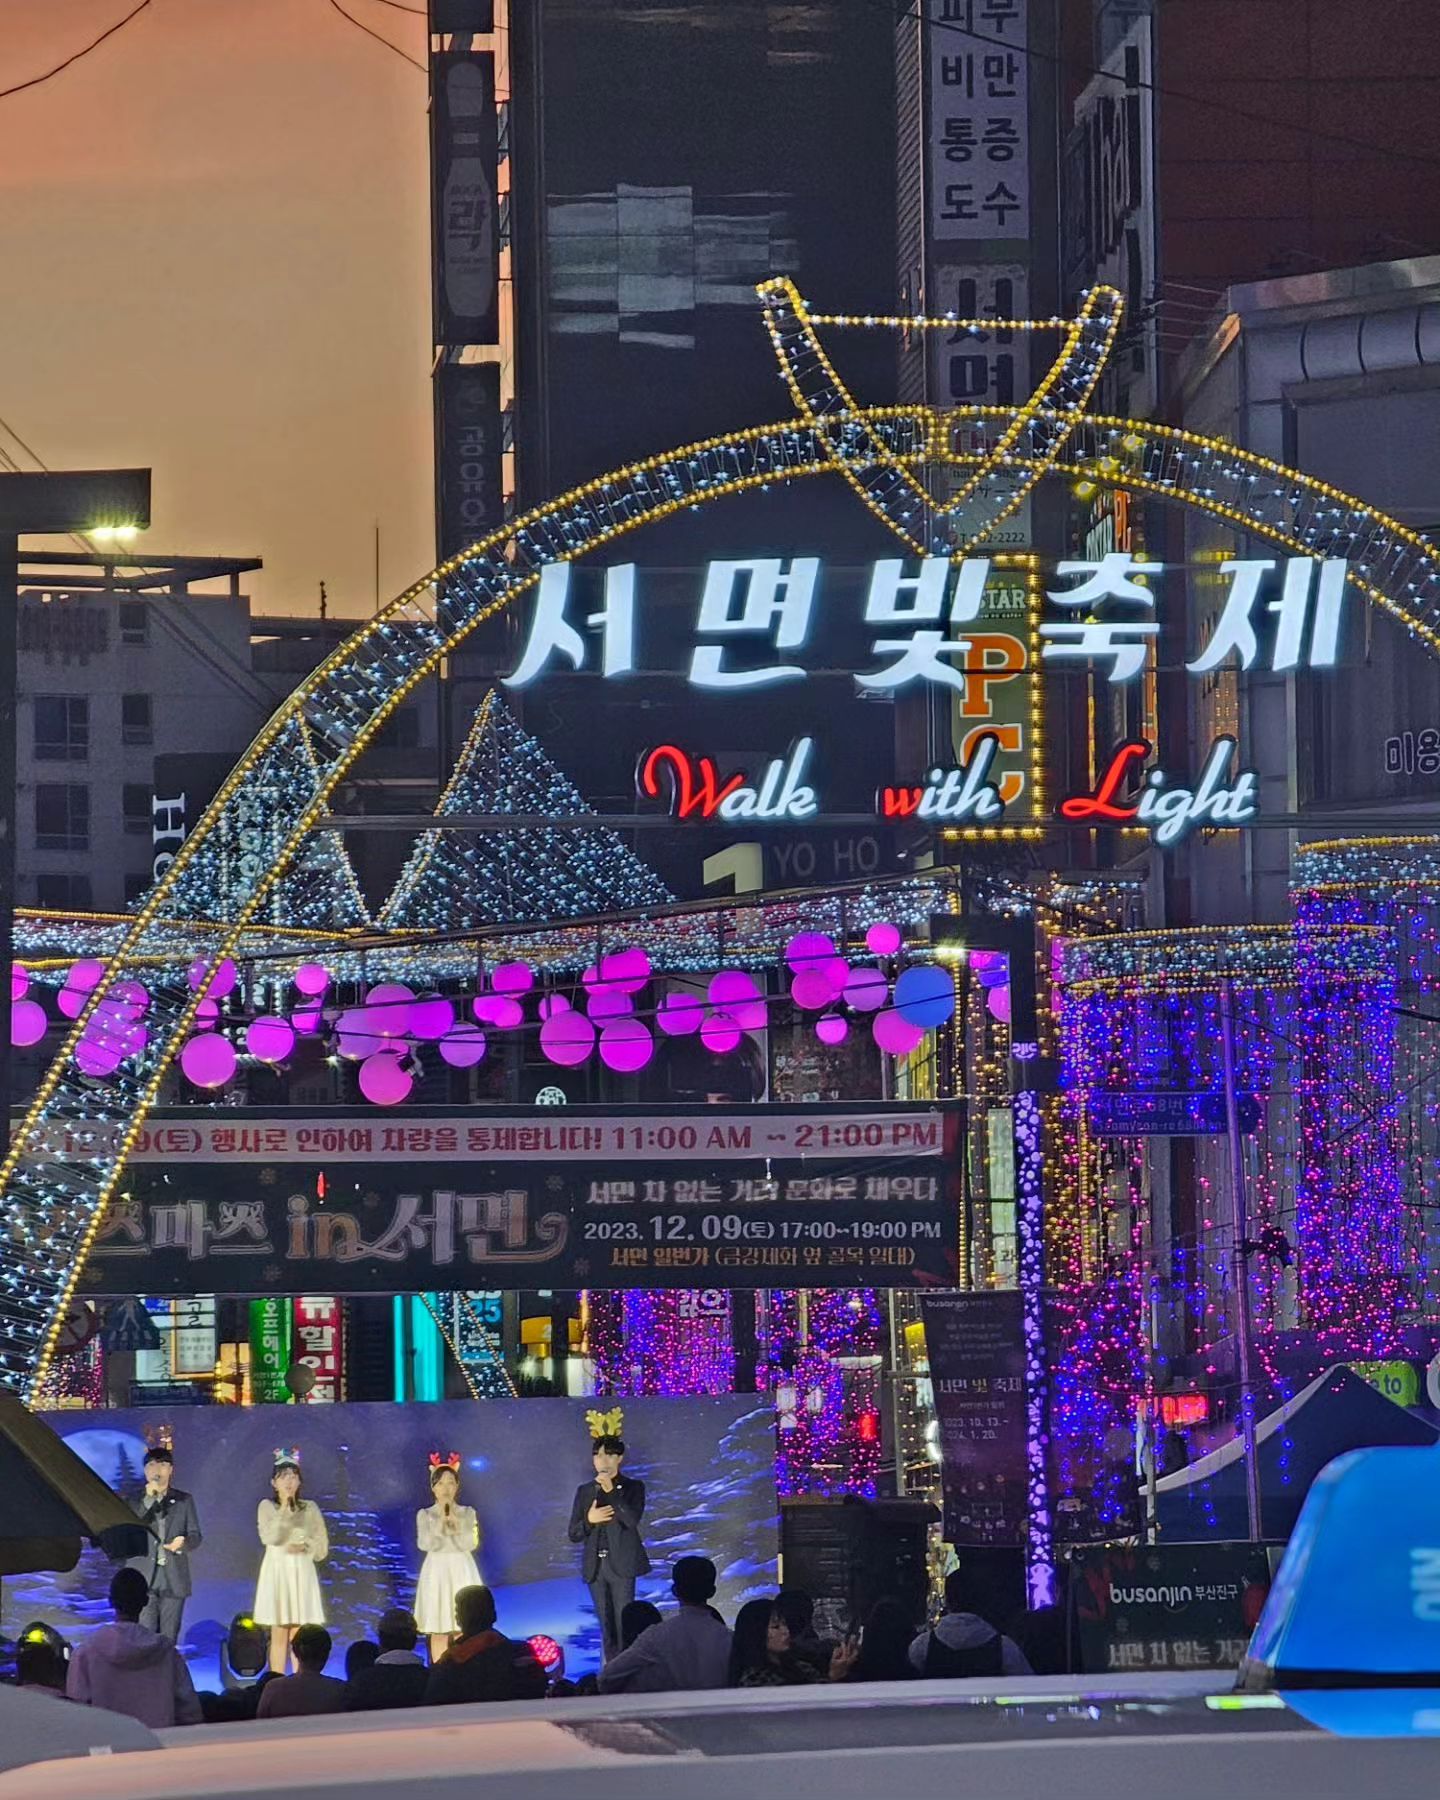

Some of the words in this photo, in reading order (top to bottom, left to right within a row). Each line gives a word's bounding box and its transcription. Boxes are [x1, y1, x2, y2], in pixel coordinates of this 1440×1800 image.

[940, 52, 1019, 98] 비만
[940, 117, 1020, 162] 통증
[940, 181, 1020, 226] 도수
[643, 736, 818, 820] Walk
[883, 737, 1003, 819] with
[1060, 738, 1257, 845] Light
[211, 1127, 289, 1153] 행사로
[296, 1127, 373, 1153] 인하여
[380, 1127, 458, 1152] 차량을
[467, 1126, 602, 1152] 통제합니다!
[612, 1126, 698, 1150] 11:00
[706, 1125, 752, 1149] AM
[794, 1123, 883, 1147] 21:00
[892, 1121, 937, 1146] PM
[585, 1180, 636, 1205] 서면
[673, 1180, 722, 1203] 없는
[864, 1176, 938, 1200] 채우다
[356, 1188, 568, 1265] 서면
[584, 1222, 643, 1240] 2023.
[649, 1215, 695, 1241] 12.
[780, 1221, 907, 1239] 17:00~19:00
[911, 1221, 941, 1239] PM
[609, 1247, 648, 1266] 서면
[263, 1388, 280, 1401] 2F
[1109, 1583, 1192, 1607] busanjin
[1194, 1584, 1238, 1600] 부산진구
